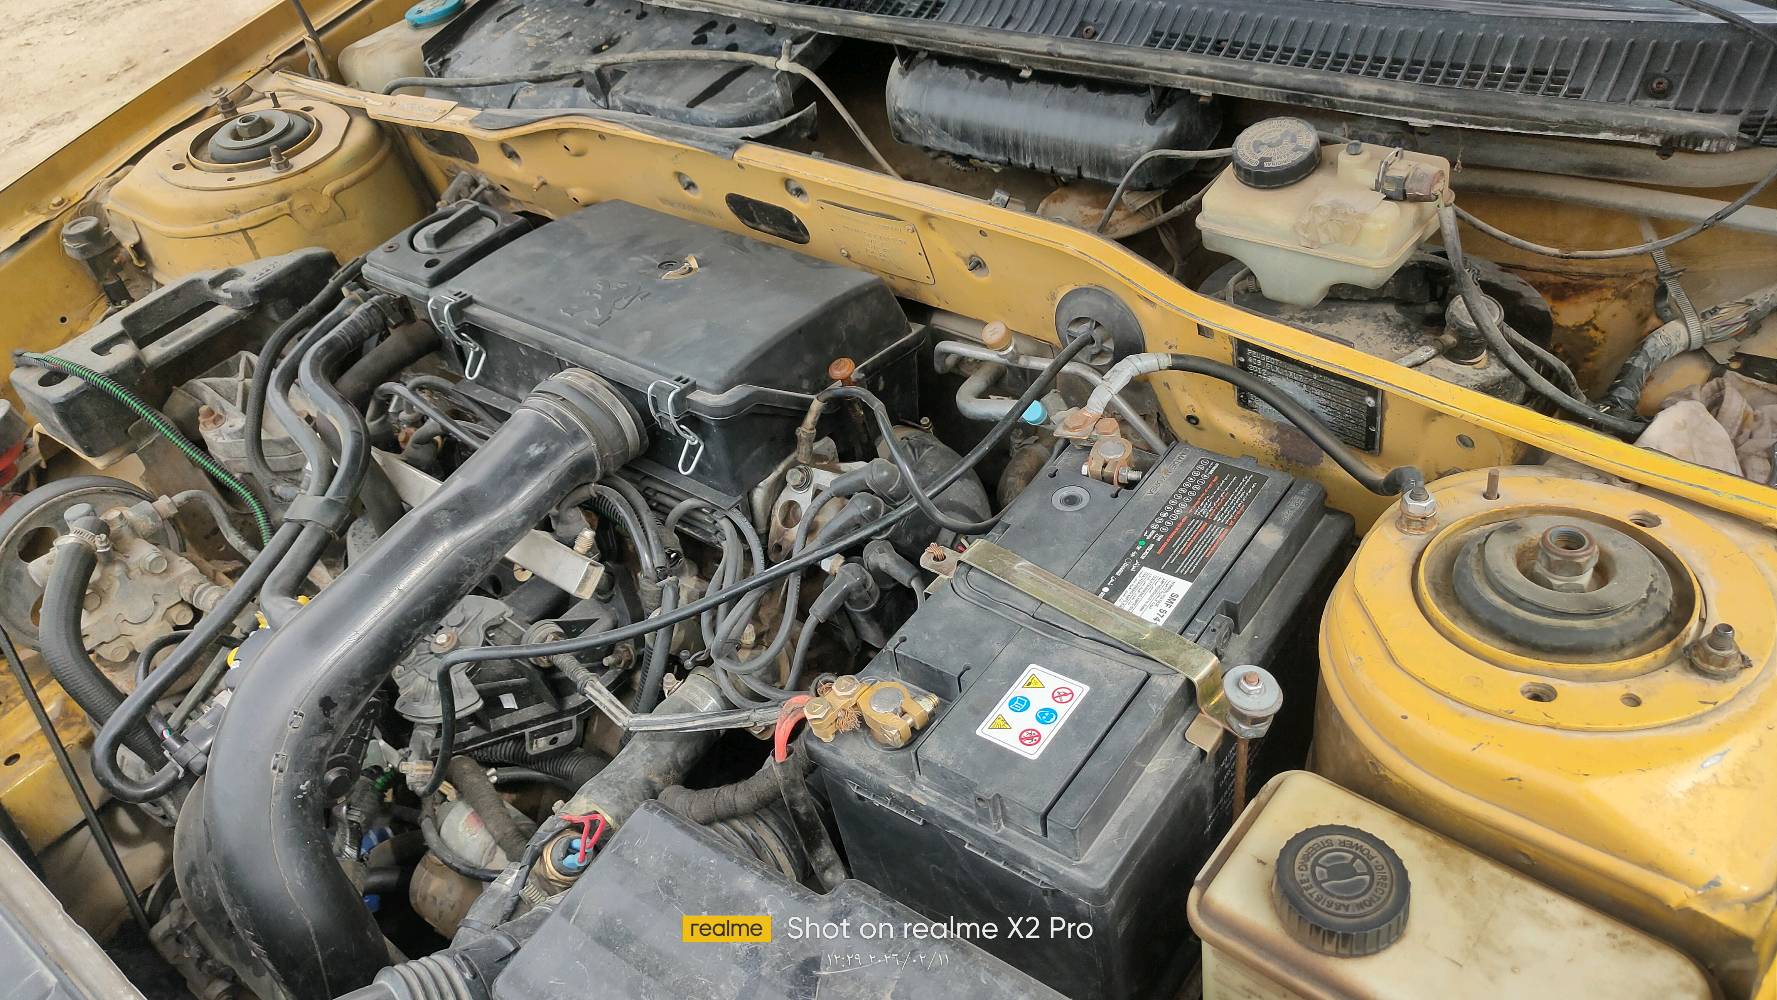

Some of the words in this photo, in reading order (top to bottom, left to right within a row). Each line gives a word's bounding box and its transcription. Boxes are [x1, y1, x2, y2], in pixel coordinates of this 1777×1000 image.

[1164, 592, 1180, 609] SMF
[1152, 608, 1168, 624] 574
[1297, 838, 1334, 872] STEERING
[1337, 839, 1377, 862] POWER
[1355, 863, 1388, 912] DIRECTION
